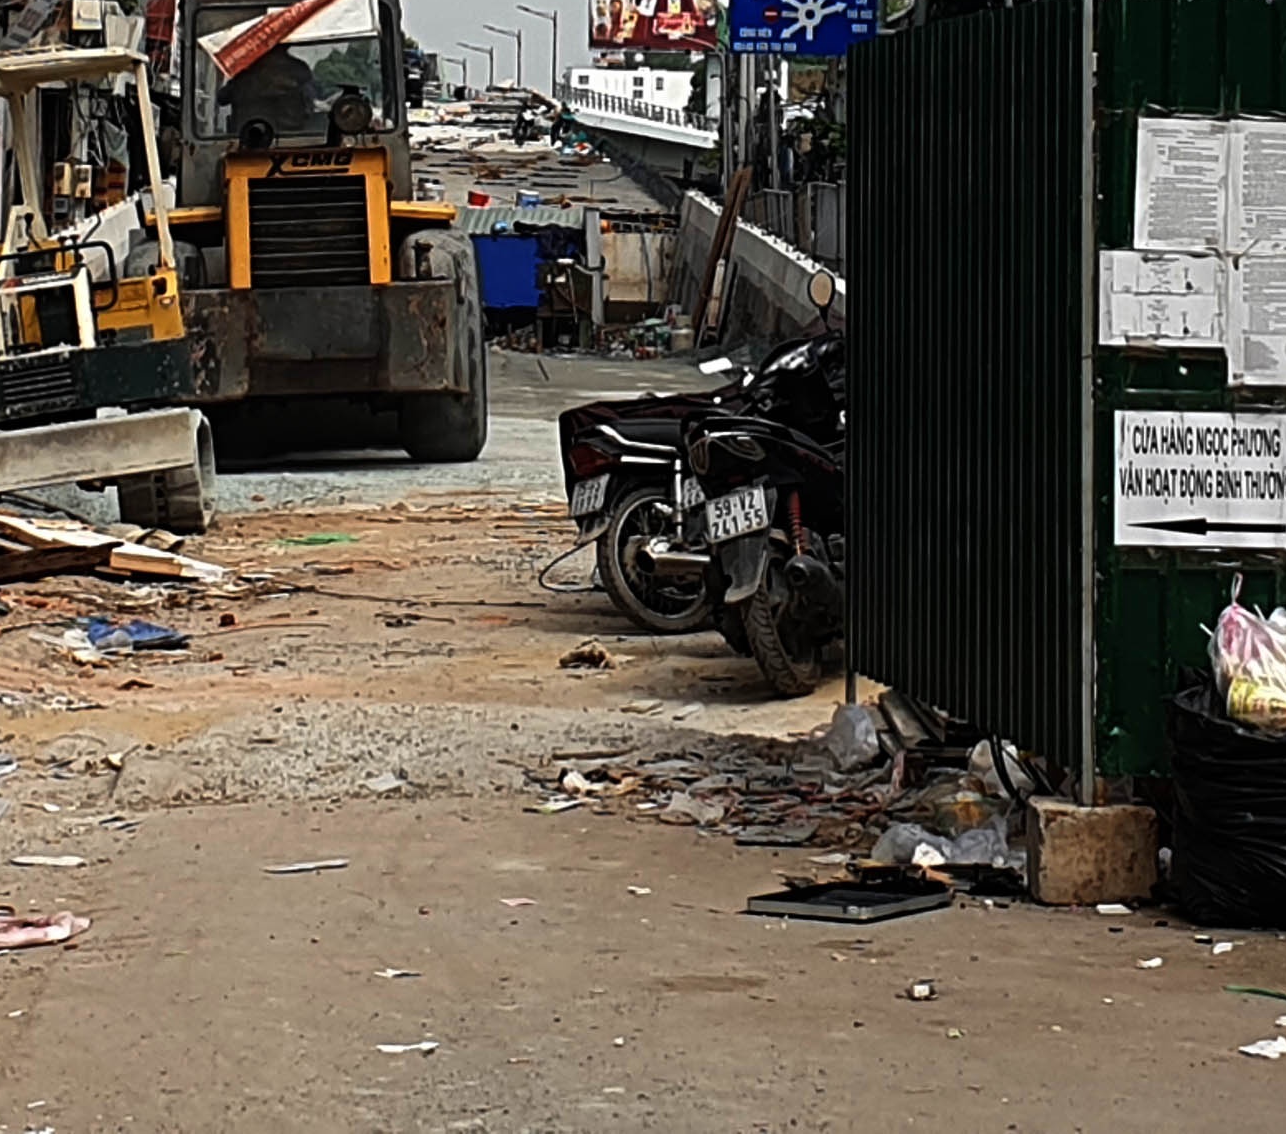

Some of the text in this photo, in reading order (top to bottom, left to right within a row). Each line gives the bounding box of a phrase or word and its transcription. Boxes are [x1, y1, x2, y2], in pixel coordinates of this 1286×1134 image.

[267, 152, 354, 178] XCMG
[1133, 418, 1281, 463] CỬA HÀNG NGỌC PHƯƠNG
[1145, 468, 1178, 505] HOẠT
[1180, 464, 1213, 505] ĐỘNG
[1216, 462, 1242, 498] BÌNH
